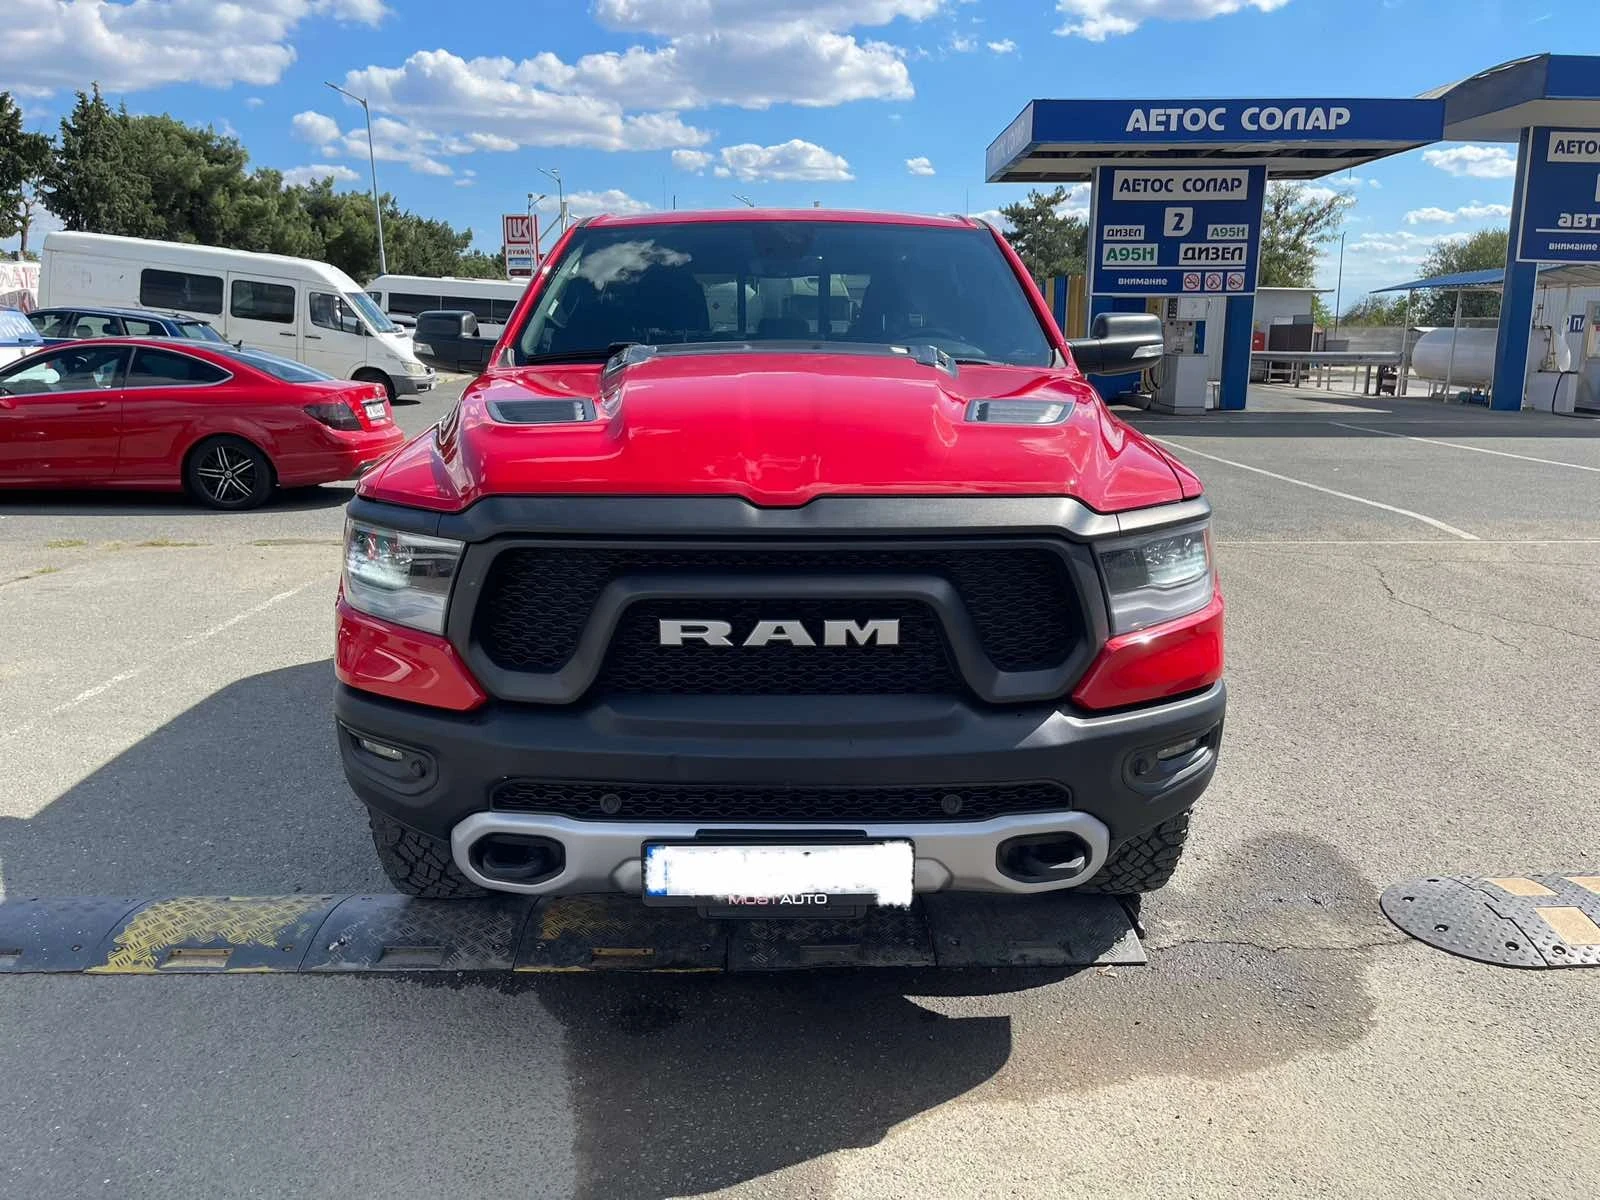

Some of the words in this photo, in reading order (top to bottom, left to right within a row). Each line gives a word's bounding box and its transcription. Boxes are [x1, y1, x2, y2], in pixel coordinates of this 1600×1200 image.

[1126, 108, 1227, 132] АЕТОС
[1240, 107, 1350, 131] СОЛАР
[1554, 140, 1600, 154] АЕТО
[1119, 178, 1174, 192] АЕТОС
[1182, 178, 1242, 192] СОЛАР
[1172, 213, 1185, 231] 2
[1106, 228, 1141, 237] ДИЗЕЛ
[1211, 227, 1245, 237] А95Н
[1106, 247, 1155, 261] А95Н
[1182, 247, 1243, 261] ДИЗЕЛ
[1118, 277, 1168, 285] внимание
[659, 619, 900, 646] RAM
